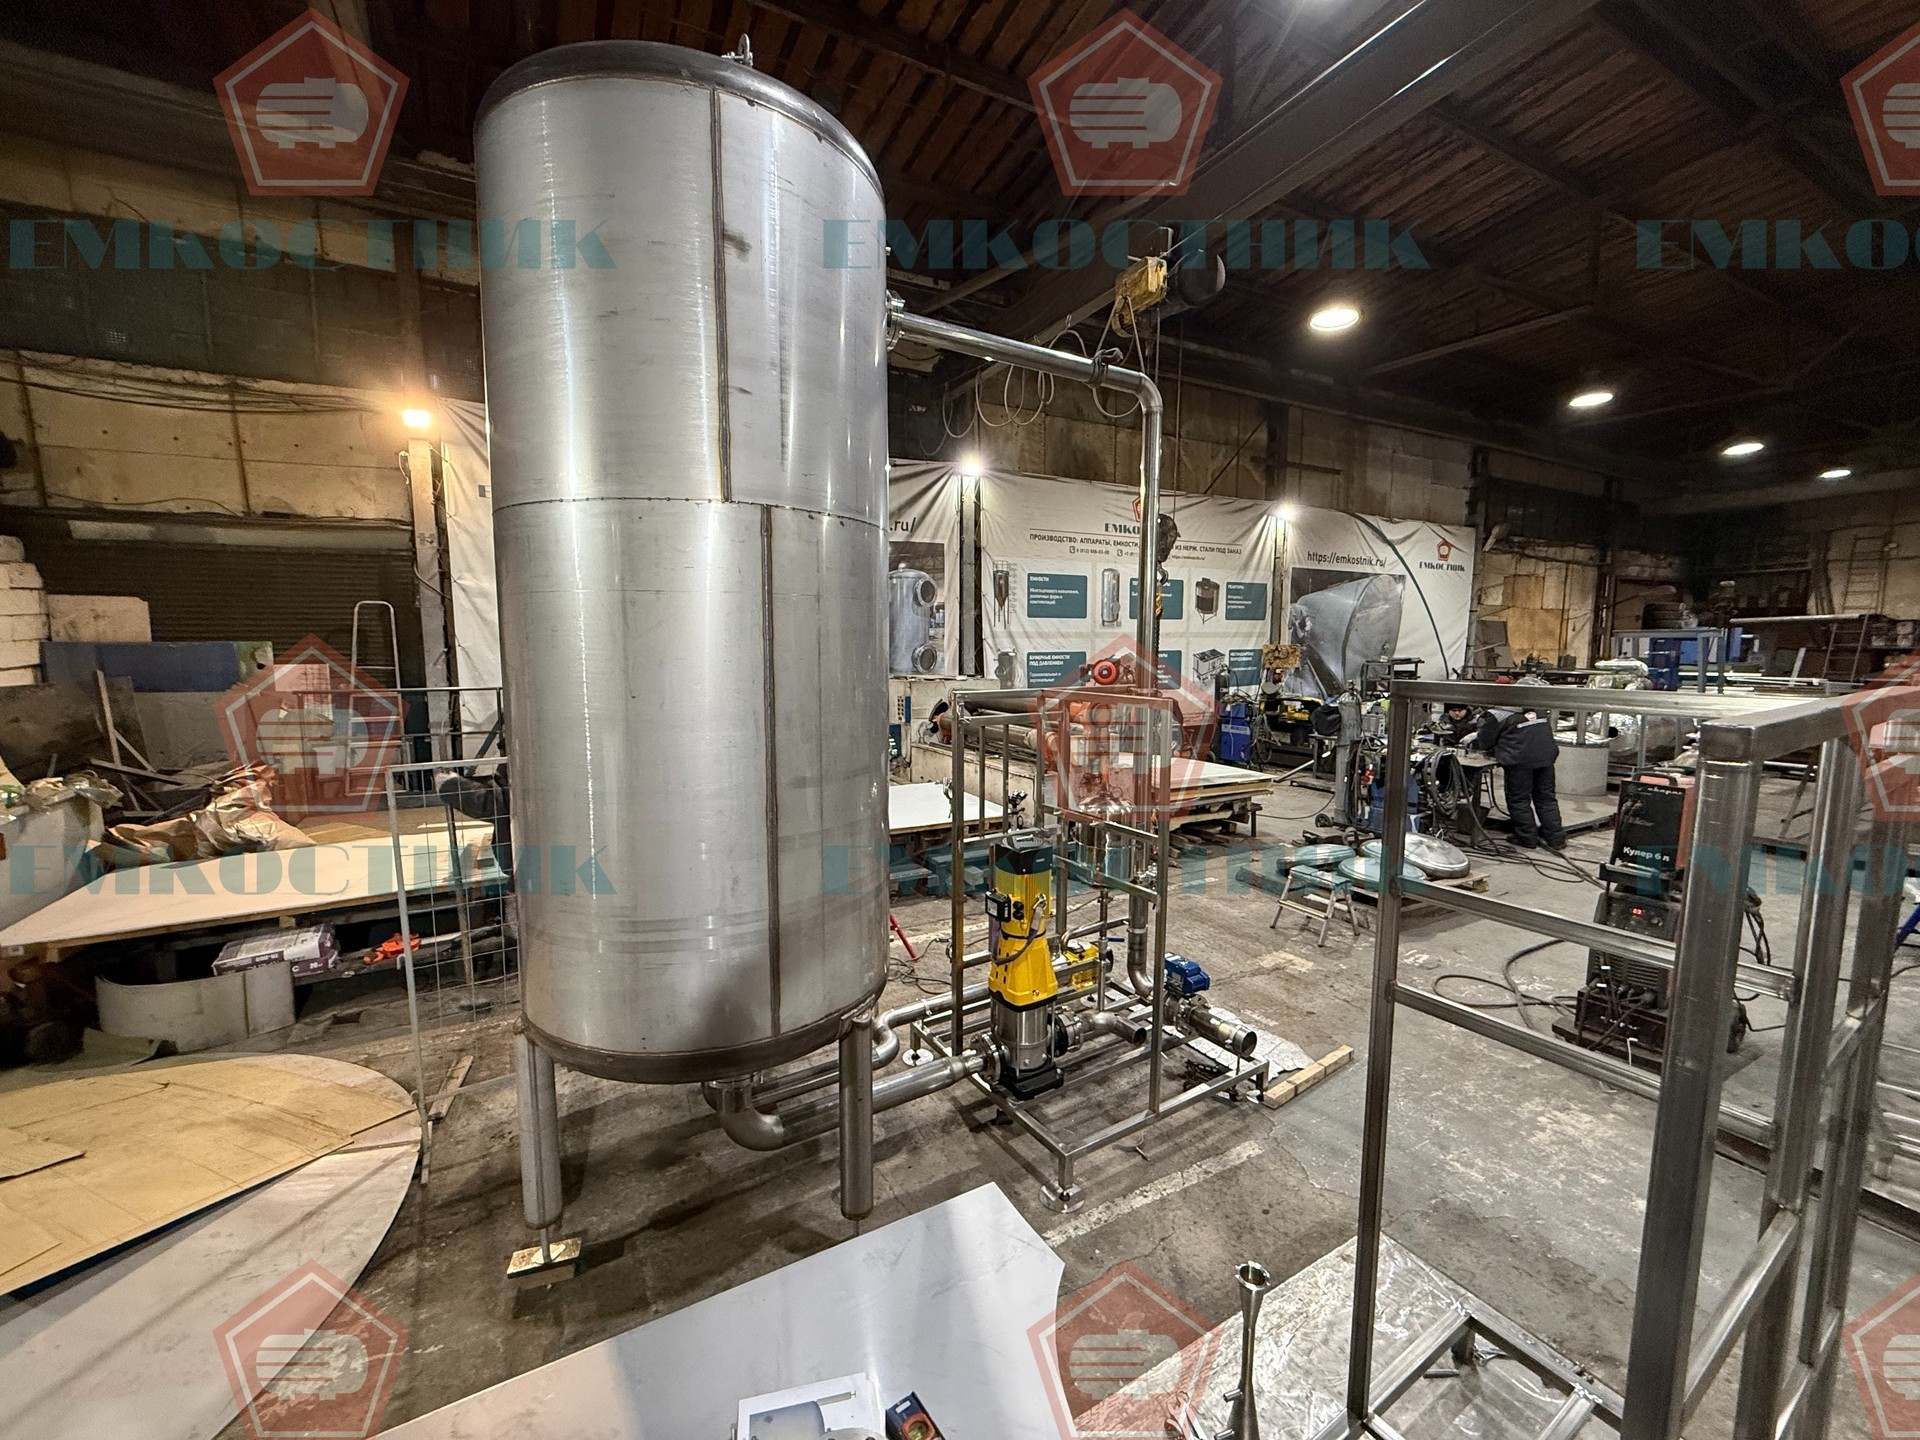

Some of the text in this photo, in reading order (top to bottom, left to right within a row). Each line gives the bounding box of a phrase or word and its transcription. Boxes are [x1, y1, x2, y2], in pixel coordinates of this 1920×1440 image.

[1029, 533, 1079, 544] ПРОИЗВОДСТВО:
[1079, 537, 1112, 547] АППАРАТЫ,
[1307, 550, 1387, 568] https://emkostnik.ru/
[1623, 846, 1653, 859] Кулер
[1654, 852, 1661, 860] 6
